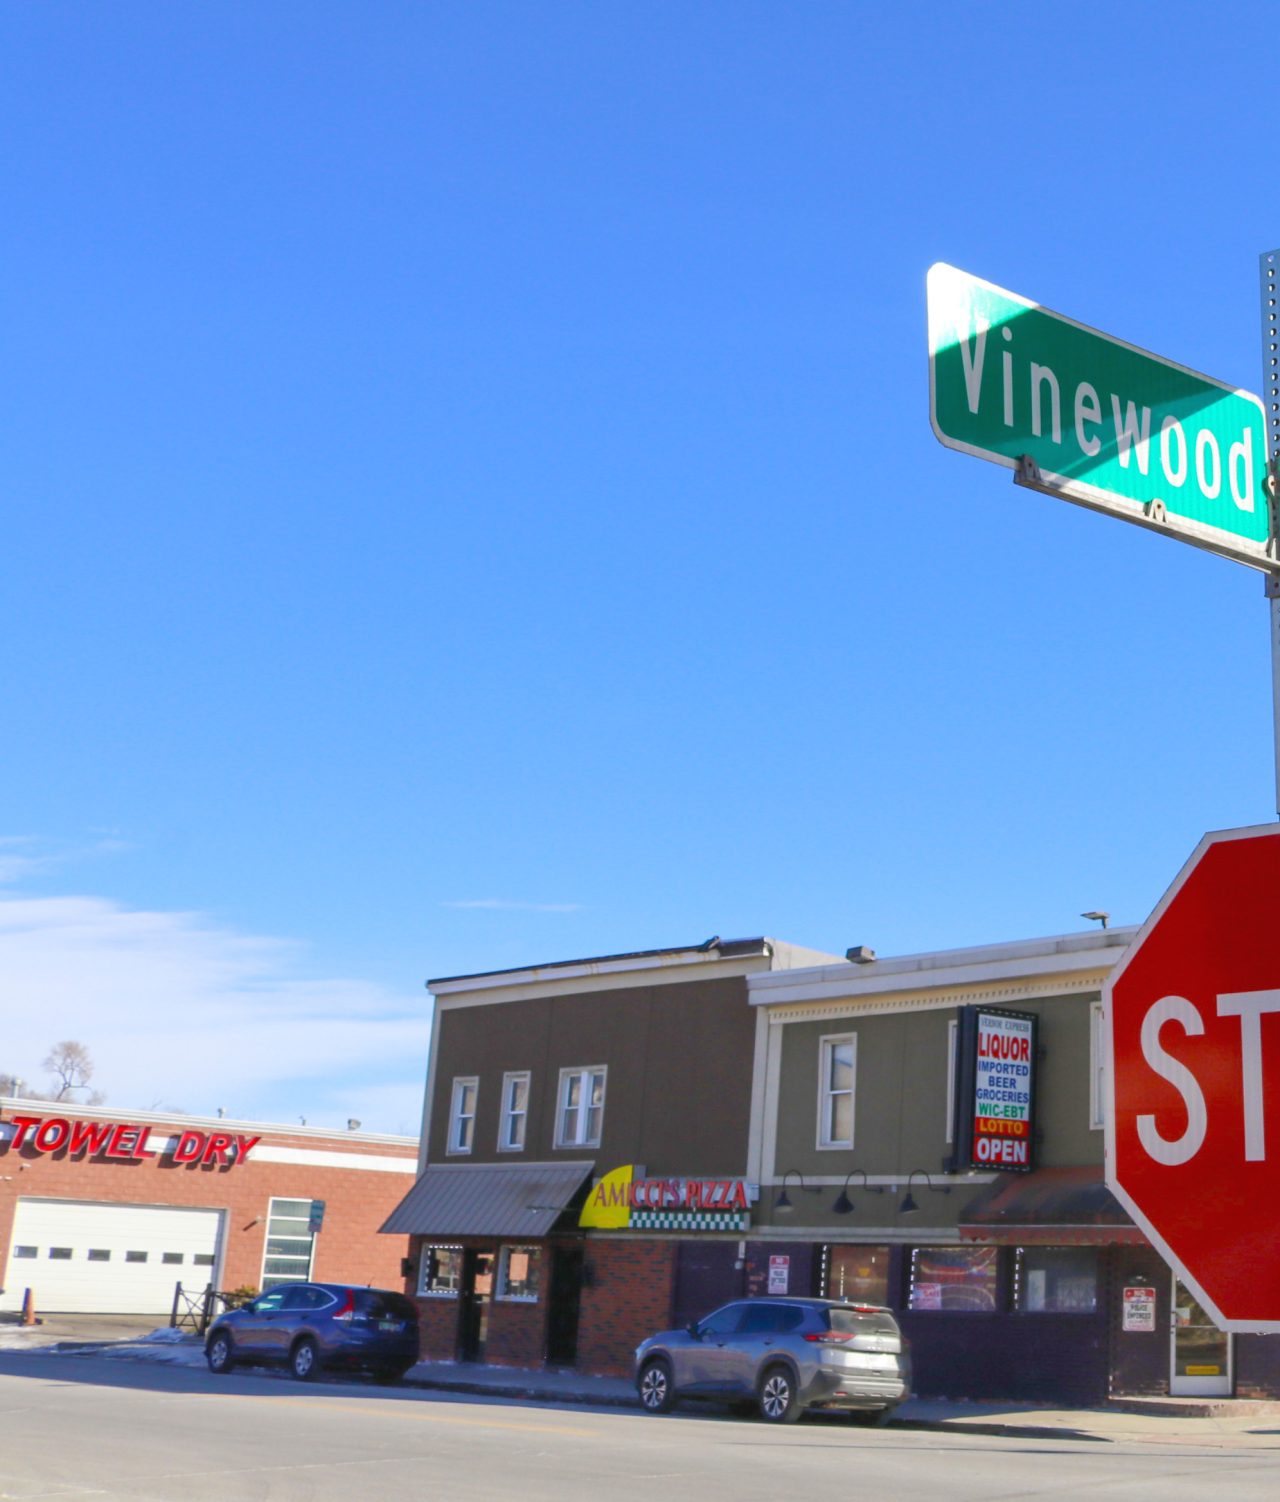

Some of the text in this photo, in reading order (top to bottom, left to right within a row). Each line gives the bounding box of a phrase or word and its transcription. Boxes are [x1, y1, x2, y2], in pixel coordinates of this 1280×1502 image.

[958, 316, 1256, 513] Vinewood
[978, 1032, 1029, 1062] LIQUOR
[978, 1060, 1028, 1076] IMPORTED
[988, 1075, 1017, 1089] BEER
[976, 1088, 1029, 1104] GROCERIES
[978, 1102, 1026, 1119] WIC-EBT
[979, 1119, 1023, 1135] LOTTO
[9, 1115, 262, 1166] TOWEL DRY
[977, 1138, 1026, 1162] OPEN
[593, 1179, 747, 1209] AMICCI'S PIZZA
